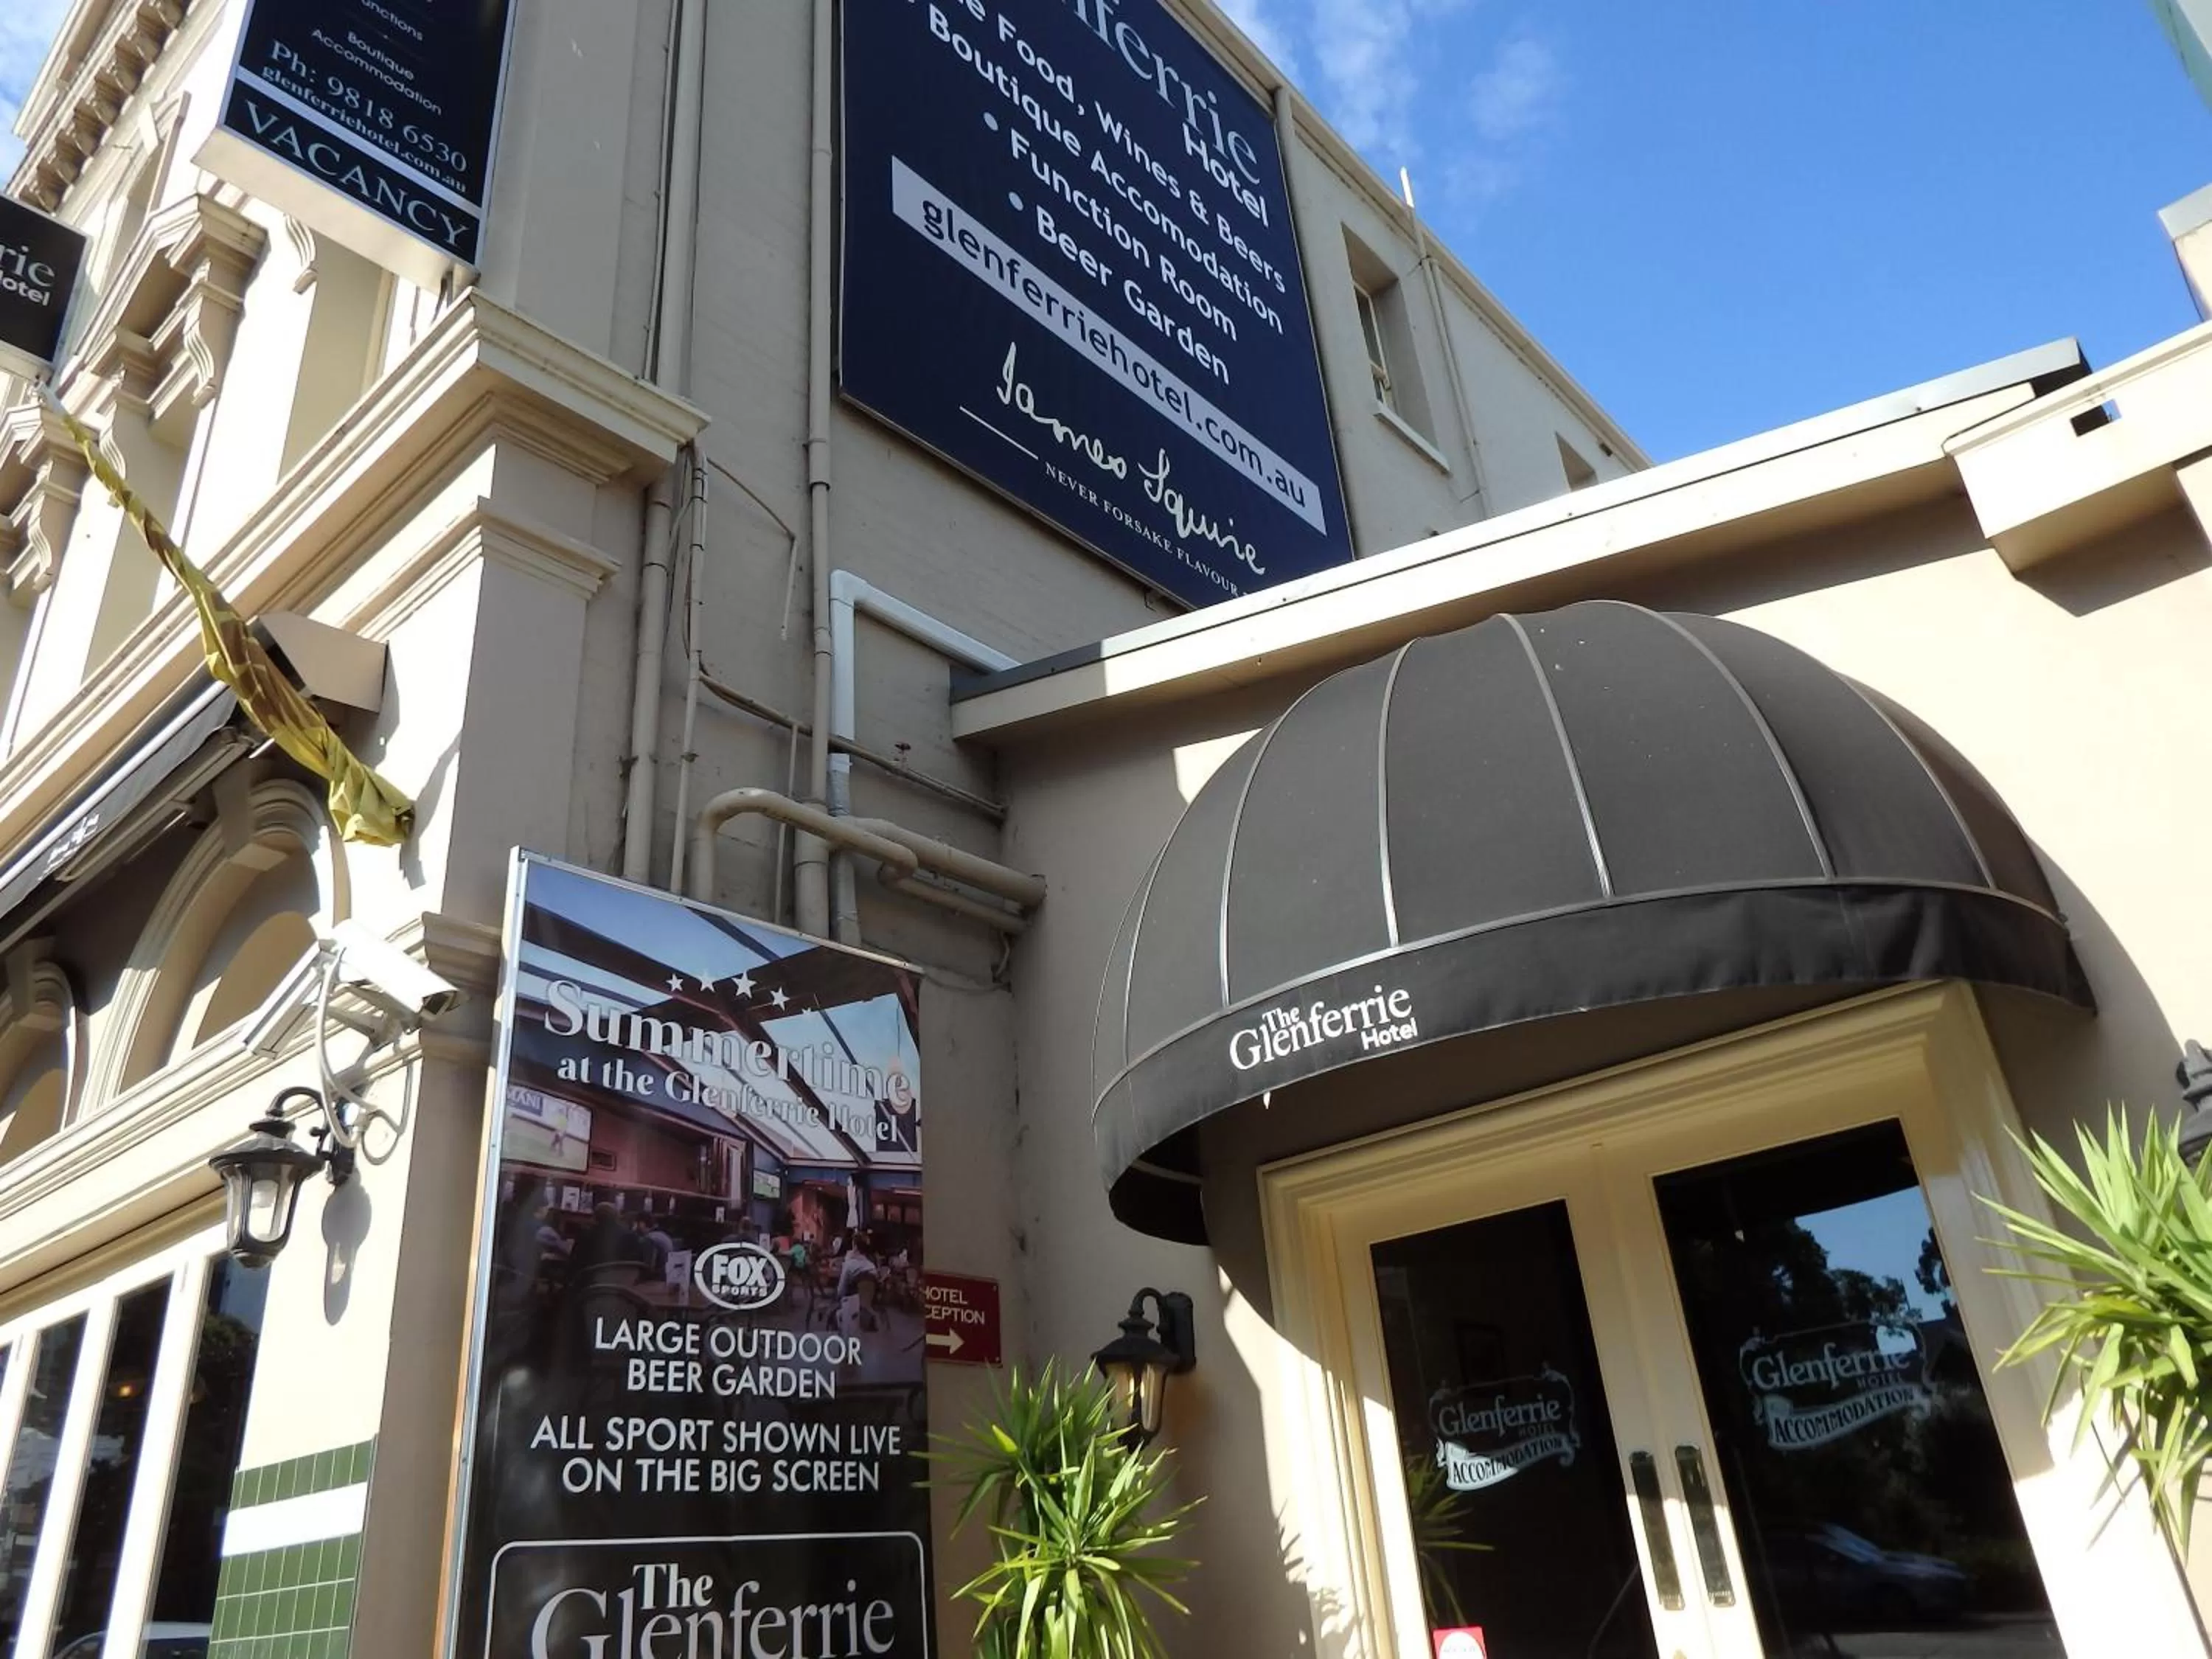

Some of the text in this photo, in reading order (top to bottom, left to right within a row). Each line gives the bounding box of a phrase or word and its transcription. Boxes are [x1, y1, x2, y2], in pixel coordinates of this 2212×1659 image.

[311, 29, 442, 115] Accommodation
[347, 32, 414, 80] Boutique
[262, 66, 467, 194] glenferriehotel.com.au
[271, 41, 467, 173] Ph: 9818 6530
[245, 100, 470, 247] VACANCY
[930, 3, 1284, 334] Boutique Accomodation
[998, 13, 1285, 293] Food, Wines & Beers
[1183, 122, 1269, 227] Hotel
[1011, 128, 1237, 341] Function Room
[1036, 204, 1229, 385] Beer Garden
[922, 198, 1305, 509] glenferriehotel.com.au
[996, 341, 1265, 575] James Squire
[1045, 462, 1239, 597] NEVER FORSAKE FLAVOUR
[544, 980, 911, 1108] Summertime
[1229, 984, 1413, 1069] Glenferrie
[1262, 1007, 1301, 1032] The
[1360, 1018, 1418, 1050] Hotel
[557, 1057, 898, 1142] at the Glenferrie Hotel
[712, 1253, 768, 1287] FOX
[712, 1284, 768, 1297] SPORTS
[595, 1318, 861, 1366] LARGE OUTDOOR
[627, 1360, 836, 1399] BEER GARDEN
[530, 1415, 901, 1455] ALL SPORT SHOWN LIVE
[1439, 1393, 1562, 1437] Glenferrie
[562, 1456, 880, 1493] ON THE BIG SCREEN
[531, 1579, 895, 1659] Glenferrie
[633, 1563, 714, 1610] The
